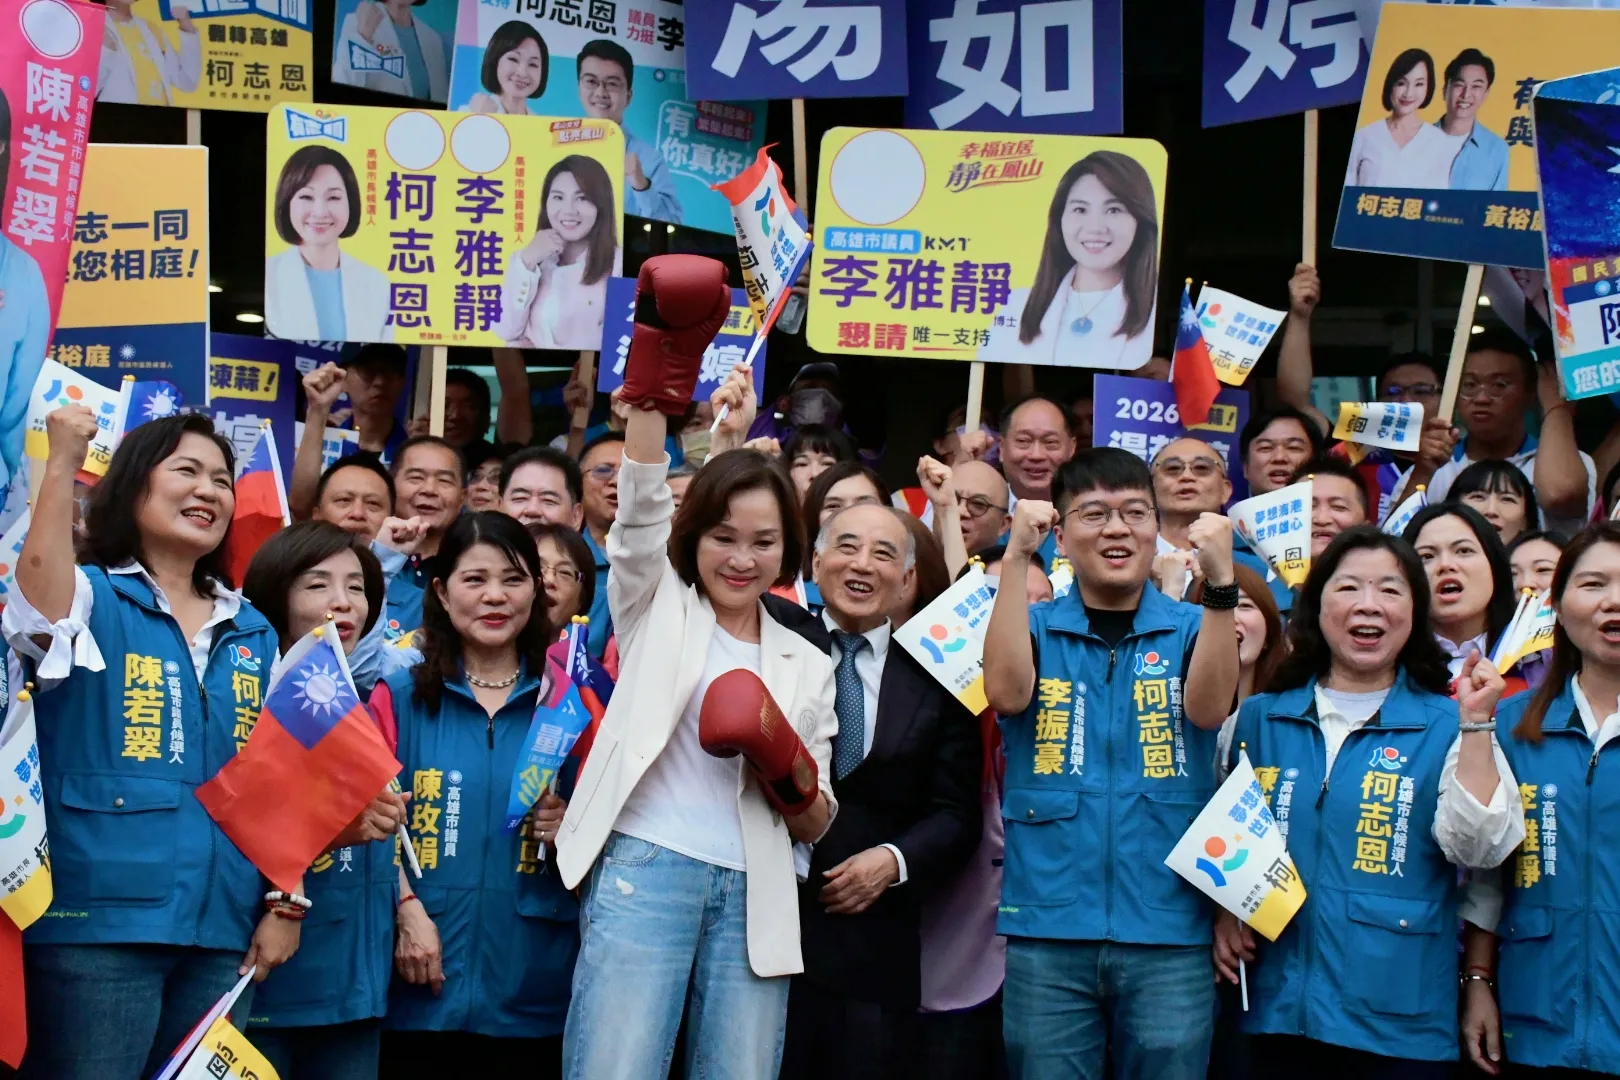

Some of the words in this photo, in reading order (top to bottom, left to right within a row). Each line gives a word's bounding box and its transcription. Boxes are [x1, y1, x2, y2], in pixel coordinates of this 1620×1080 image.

[627, 26, 655, 46] 力挺
[206, 59, 307, 91] 柯志恩
[928, 0, 1094, 131] 如
[664, 106, 694, 138] 有
[8, 62, 74, 246] 陳若翠
[959, 139, 1035, 159] 幸福宜居
[944, 158, 1044, 193] 靜在鳳山
[514, 156, 525, 244] 高雄市議員候選人
[1356, 193, 1424, 220] 柯志恩
[72, 208, 189, 244] 志一同
[825, 231, 916, 252] 高雄市議員
[924, 235, 969, 251] KMT
[64, 247, 199, 285] 您相庭!
[384, 171, 437, 328] 柯志恩
[454, 175, 505, 332] 李雅靜
[819, 255, 1012, 315] 李雅靜
[836, 321, 908, 351] 懇請
[913, 326, 991, 348] 唯一支持
[993, 314, 1019, 328] 博士
[1224, 324, 1268, 347] 世界雄心
[50, 344, 111, 369] 裕庭
[1115, 397, 1180, 424] 2026
[1254, 498, 1304, 525] 夢想海港
[1255, 517, 1304, 543] 世界雄心
[121, 653, 166, 762] 陳若翠
[166, 675, 185, 765] 高雄市議員候選人
[231, 670, 263, 754] 柯志
[1033, 677, 1072, 776] 李振豪
[1133, 679, 1176, 779] 柯志恩
[1168, 676, 1189, 778] 高雄市長候選人
[409, 767, 444, 872] 陳玫娟
[443, 786, 462, 858] 高雄市議員
[1274, 780, 1296, 843] 高雄市議
[1352, 770, 1399, 875] 柯志恩
[1389, 776, 1414, 878] 高雄市長候選人
[1541, 800, 1558, 877] 高雄市議員
[0, 857, 32, 887] 高雄市長
[1263, 857, 1297, 893] 柯
[1240, 882, 1262, 910] 高雄市長
